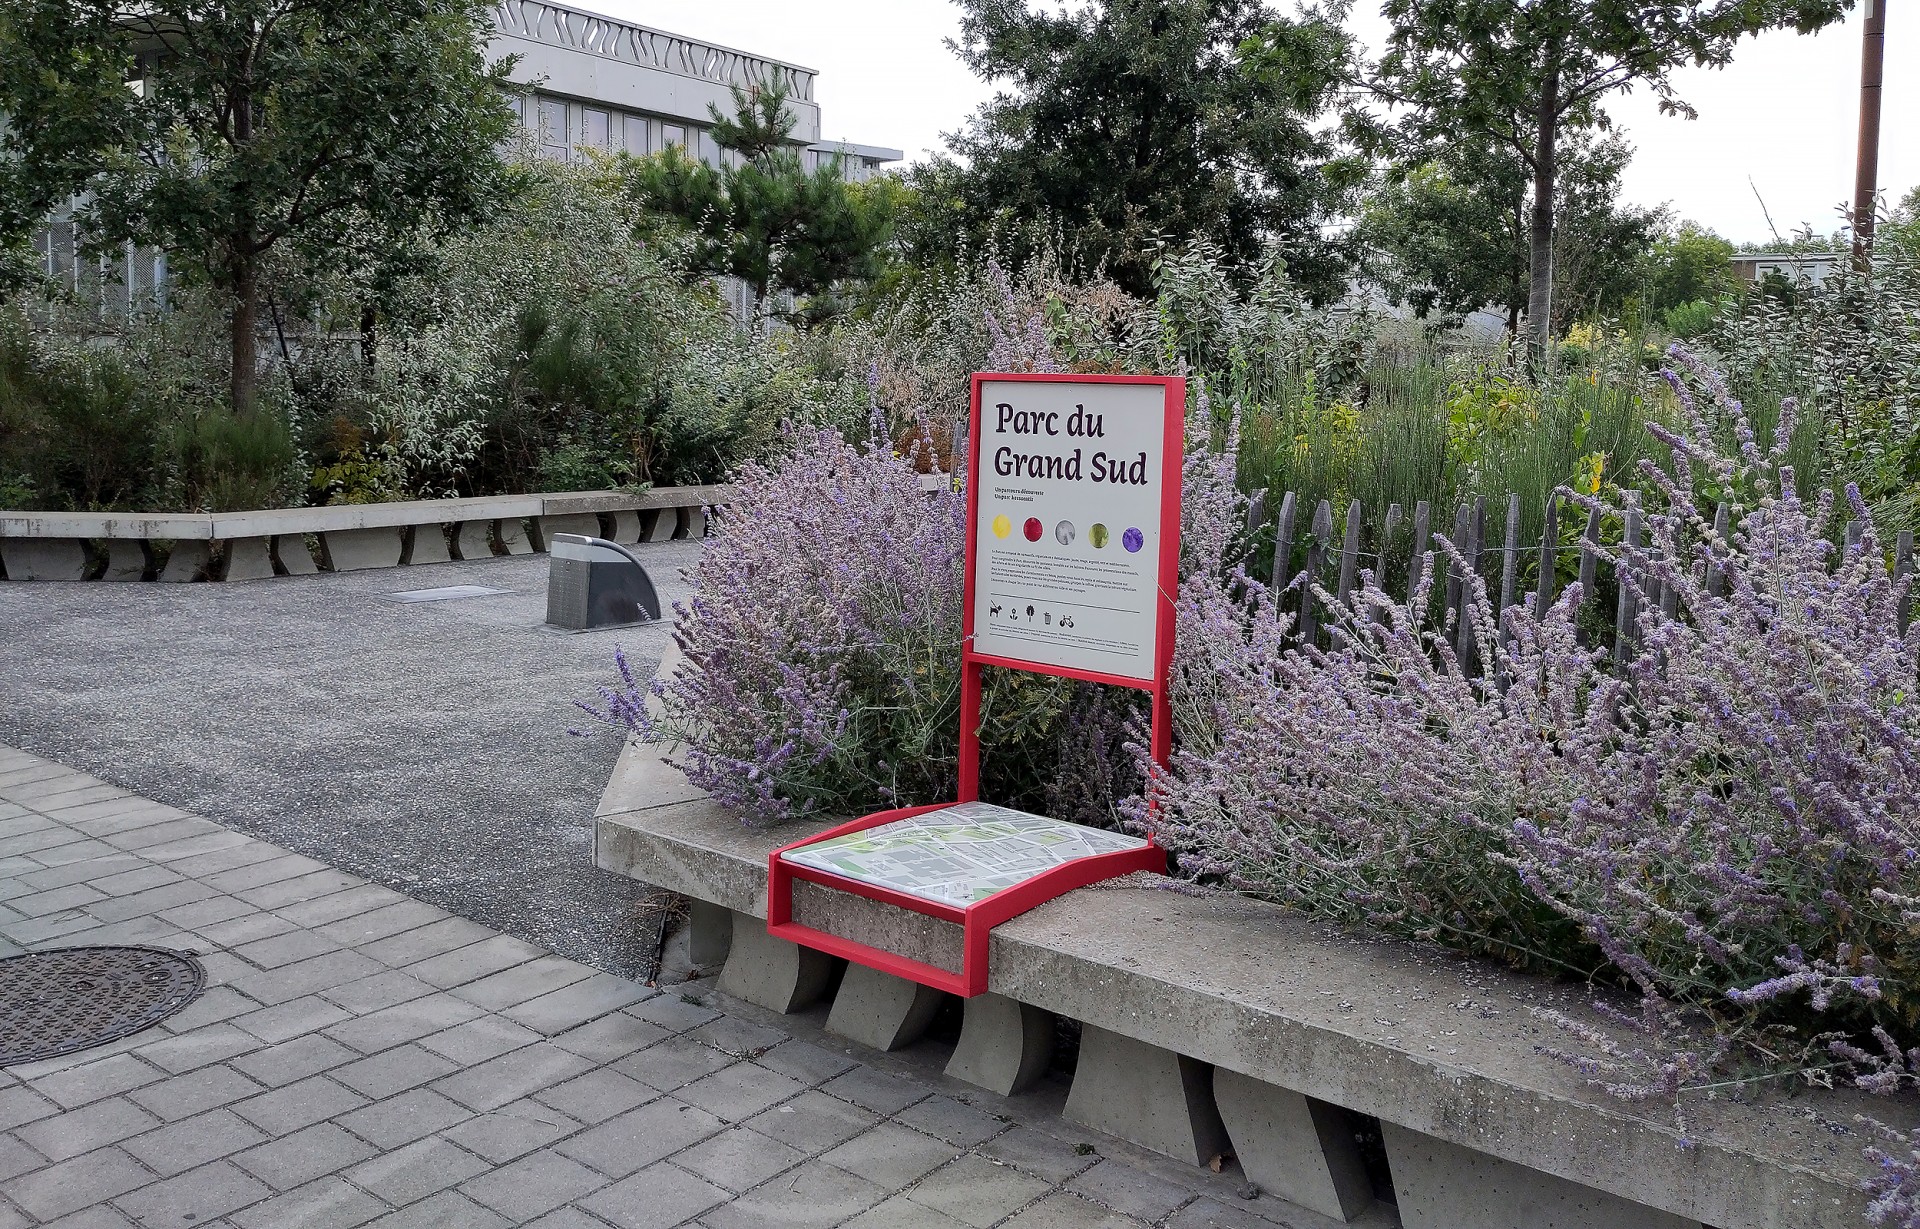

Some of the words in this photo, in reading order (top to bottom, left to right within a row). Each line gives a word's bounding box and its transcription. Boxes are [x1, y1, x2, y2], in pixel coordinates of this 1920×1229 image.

[995, 403, 1059, 436] Parc
[1066, 403, 1105, 438] du
[994, 446, 1083, 482] Grand
[1090, 451, 1148, 486] Sud
